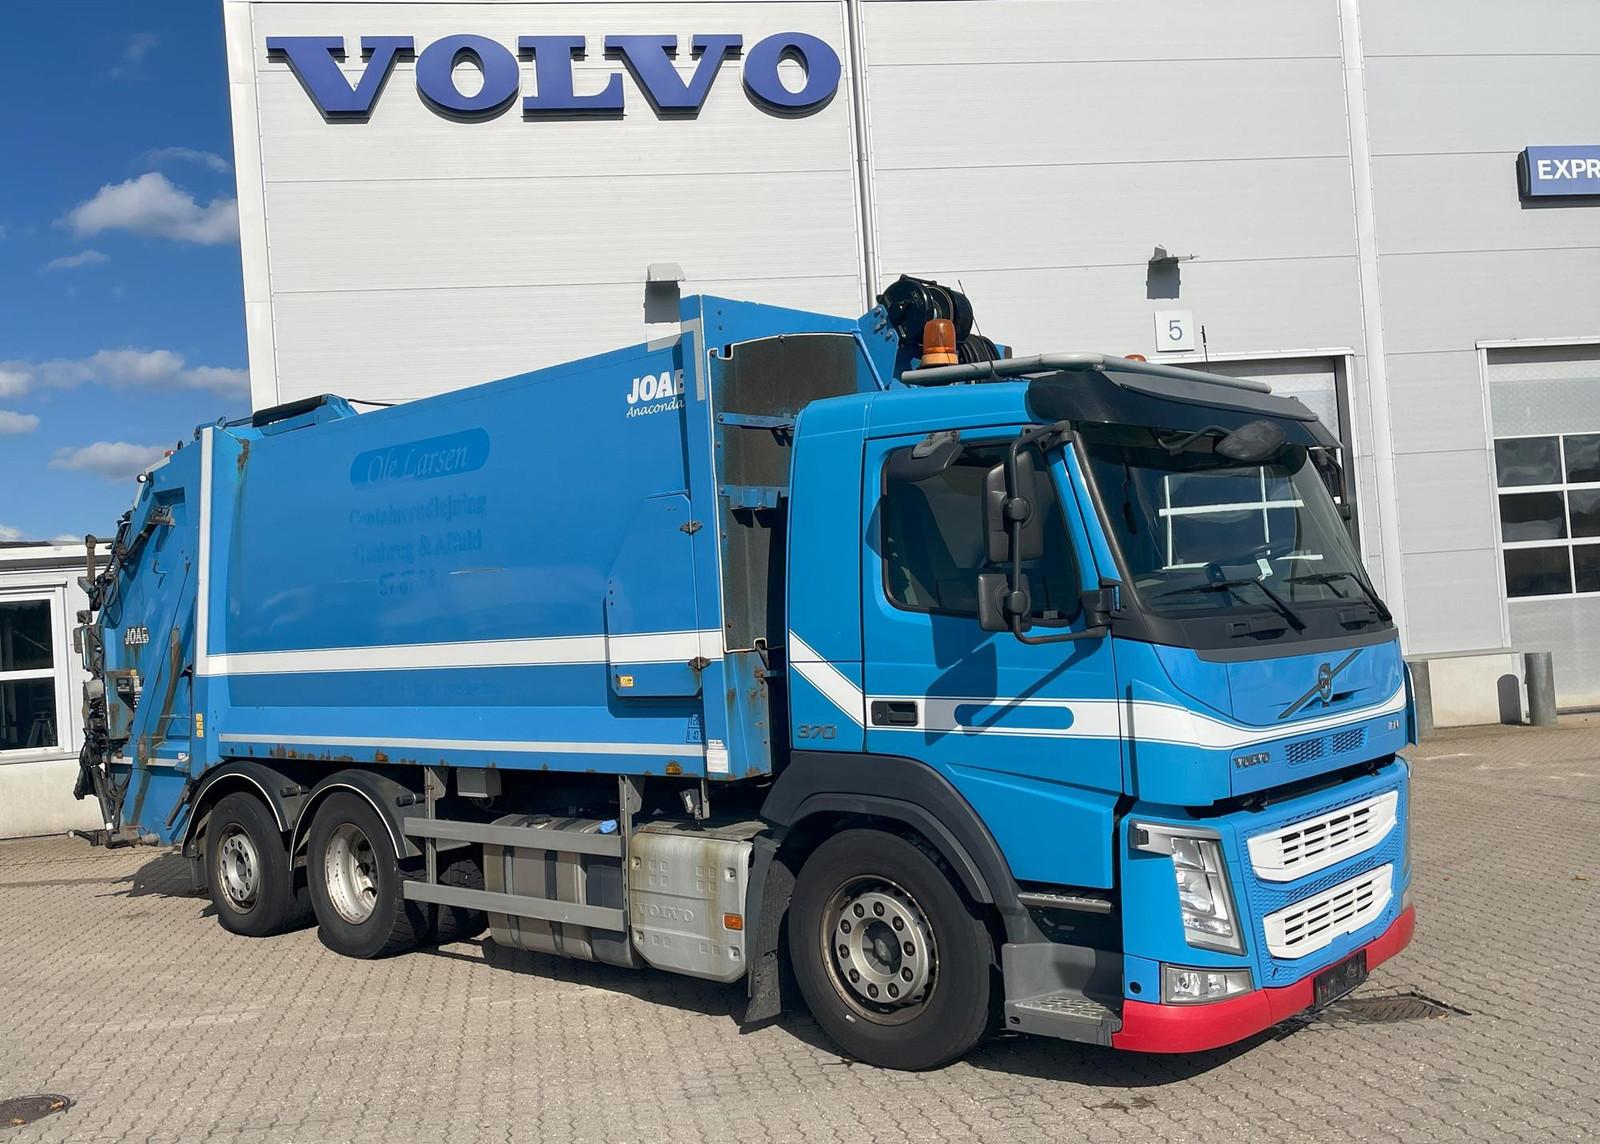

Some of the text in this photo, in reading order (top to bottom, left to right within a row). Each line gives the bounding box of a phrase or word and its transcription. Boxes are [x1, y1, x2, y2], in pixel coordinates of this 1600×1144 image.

[266, 32, 841, 121] VOLVO
[1537, 158, 1600, 180] EXPR
[1169, 319, 1183, 341] 5
[626, 397, 685, 418] Anaconda
[367, 446, 469, 485] Ole Larsen
[797, 724, 837, 740] 370
[635, 903, 695, 922] VOLVO
